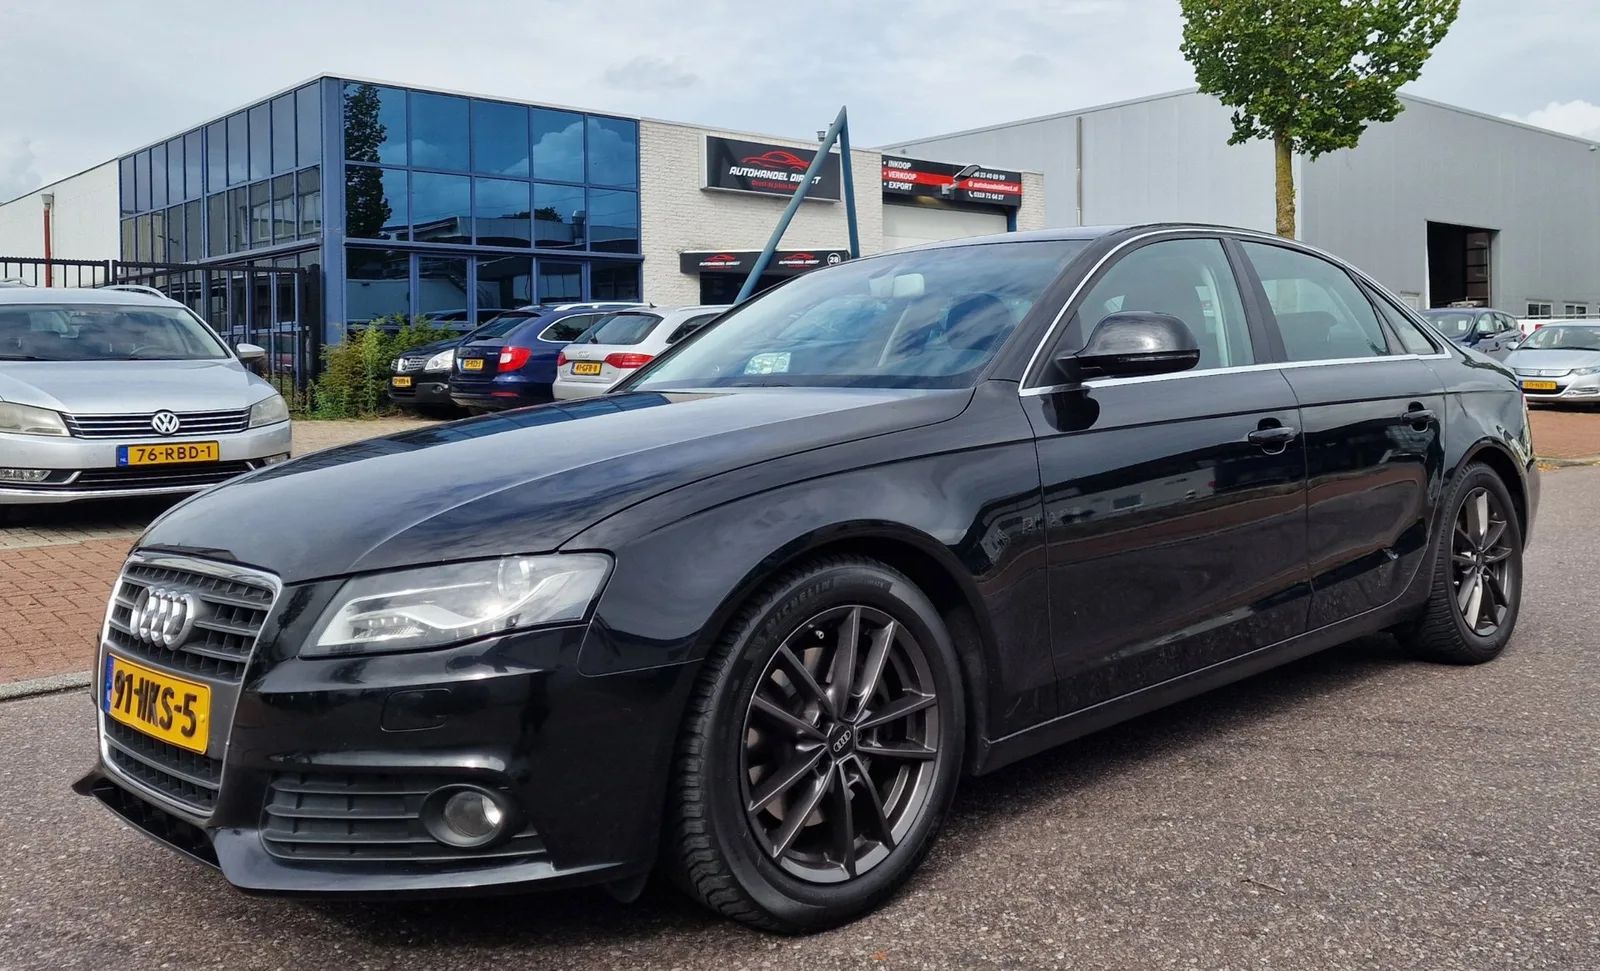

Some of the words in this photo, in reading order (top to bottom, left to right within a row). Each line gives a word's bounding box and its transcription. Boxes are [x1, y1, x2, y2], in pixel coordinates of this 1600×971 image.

[888, 160, 911, 170] INKOOP
[729, 166, 788, 181] AUTOHANDEL
[888, 171, 917, 180] VERKOOP
[888, 182, 913, 191] EXPORT
[136, 445, 212, 462] 76-RBD-1
[765, 579, 832, 634] MICHELIN
[114, 668, 198, 739] 91-HKS-5
